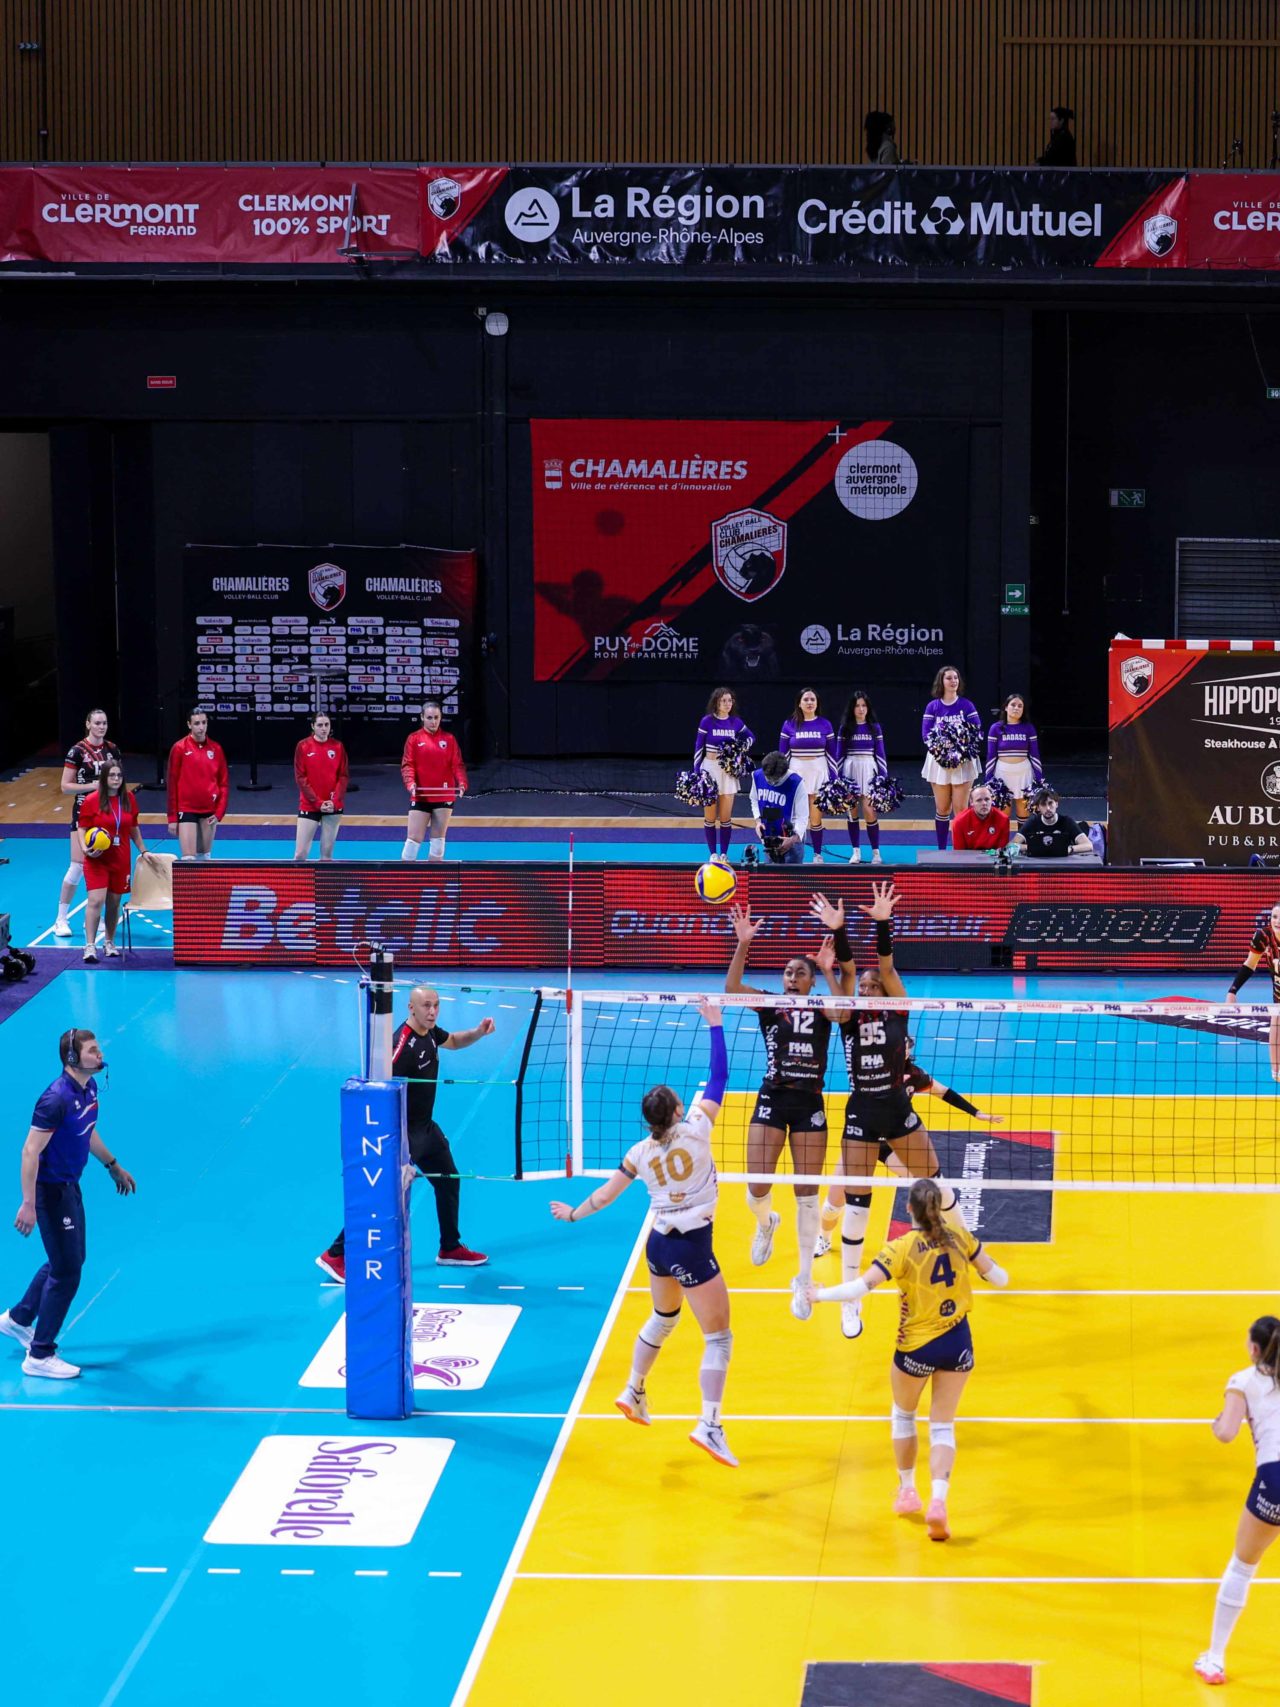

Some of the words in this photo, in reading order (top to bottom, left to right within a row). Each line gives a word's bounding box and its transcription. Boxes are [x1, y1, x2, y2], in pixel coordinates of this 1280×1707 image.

[571, 186, 614, 218] La
[626, 186, 765, 225] Région
[1233, 201, 1265, 209] VILLE
[798, 199, 917, 236] Crédit
[970, 202, 1102, 237] Mutuel
[252, 217, 310, 235] 100%
[316, 214, 390, 236] SPORT
[571, 227, 764, 246] Auvergne-Rhône-Alpes
[569, 454, 748, 480] CHAMALIÈRES
[849, 462, 901, 475] clermont
[570, 481, 589, 491] Ville
[594, 482, 606, 490] de
[609, 482, 655, 491] référence
[658, 483, 668, 491] et
[671, 482, 732, 491] d'innovation
[845, 474, 897, 486] auvergne
[850, 482, 907, 497] métropole
[720, 528, 740, 539] CLUB
[837, 624, 869, 641] La
[873, 623, 944, 646] Région
[594, 651, 620, 660] MON
[837, 646, 944, 657] Auvergne-Rhône-Alpes
[712, 729, 735, 737] BADASS
[795, 731, 821, 739] BADASS
[1204, 739, 1266, 750] Steakhouse
[1268, 737, 1278, 750] À
[758, 788, 787, 806] PHOTO
[178, 812, 183, 820] 7
[1207, 806, 1244, 826] AU
[220, 883, 507, 952] Betclic
[659, 994, 677, 1002] PHA
[807, 999, 824, 1007] PHA
[956, 1001, 973, 1009] PHA
[1104, 1004, 1121, 1012] PHA
[1251, 1005, 1269, 1013] PHA
[791, 1010, 815, 1034] 12
[859, 1022, 886, 1046] 95
[861, 1054, 884, 1066] PHA
[758, 1105, 771, 1119] 12
[648, 1147, 694, 1187] 10
[930, 1252, 956, 1288] 4
[270, 1440, 397, 1540] Saforelle
